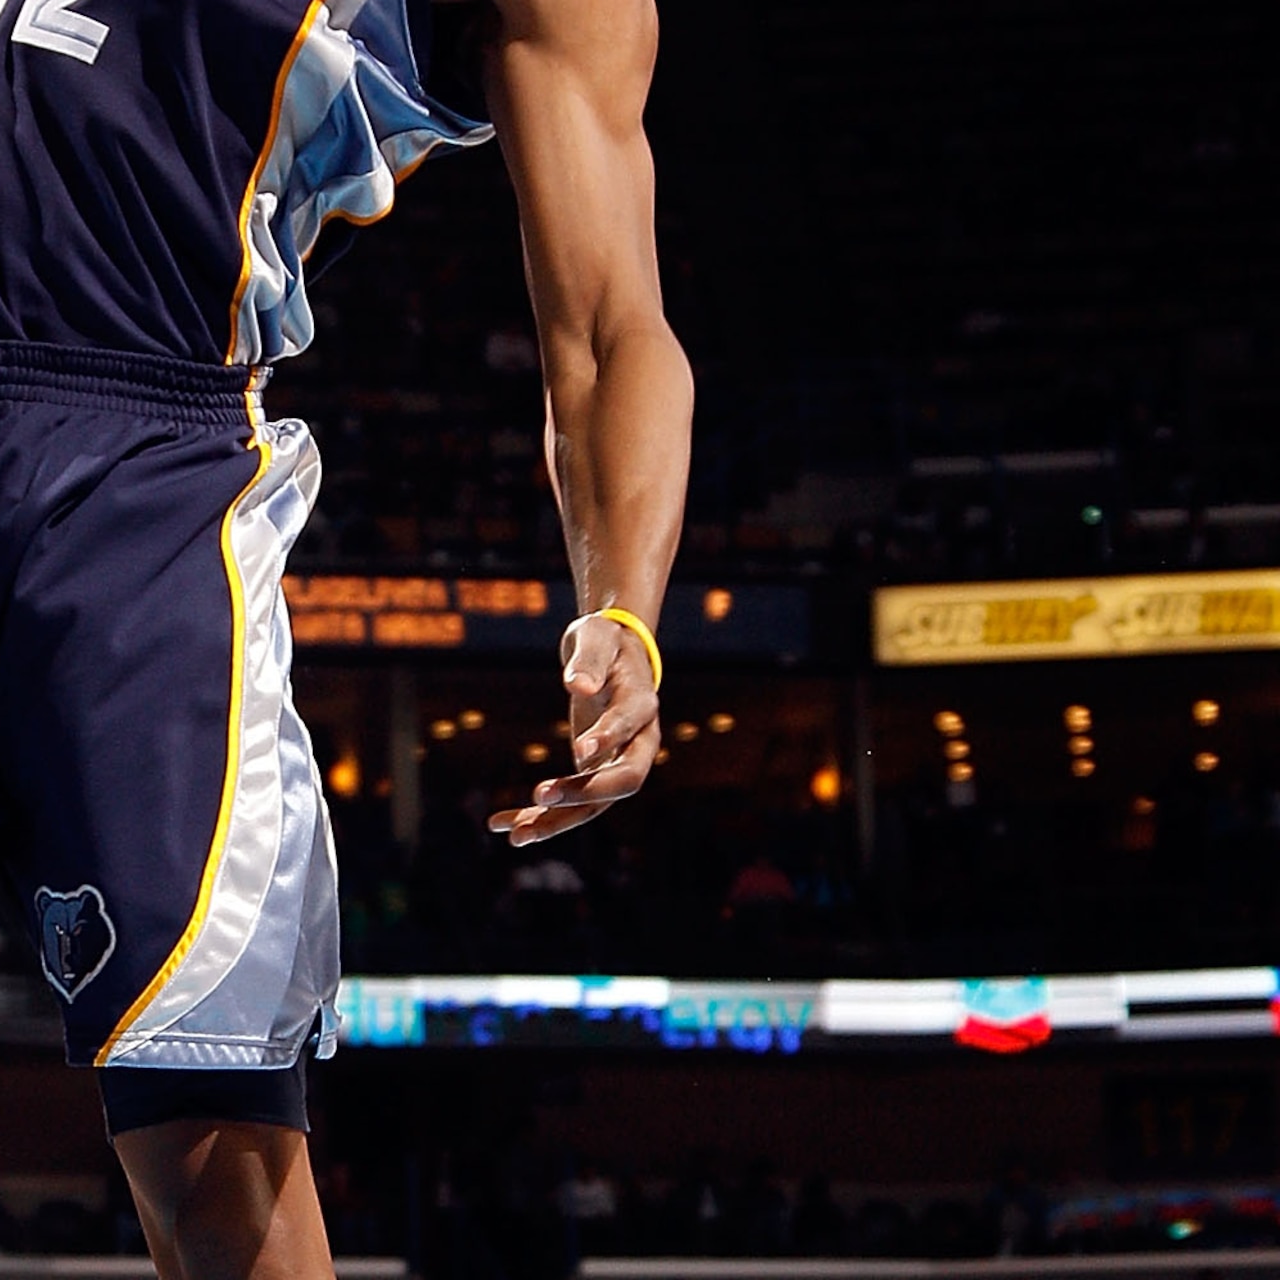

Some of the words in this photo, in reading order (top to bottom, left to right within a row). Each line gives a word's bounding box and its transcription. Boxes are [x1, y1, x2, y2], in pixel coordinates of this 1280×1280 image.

[893, 593, 1097, 648] SUBWAY
[1111, 587, 1280, 641] SUBWA
[1127, 1092, 1248, 1158] 117
